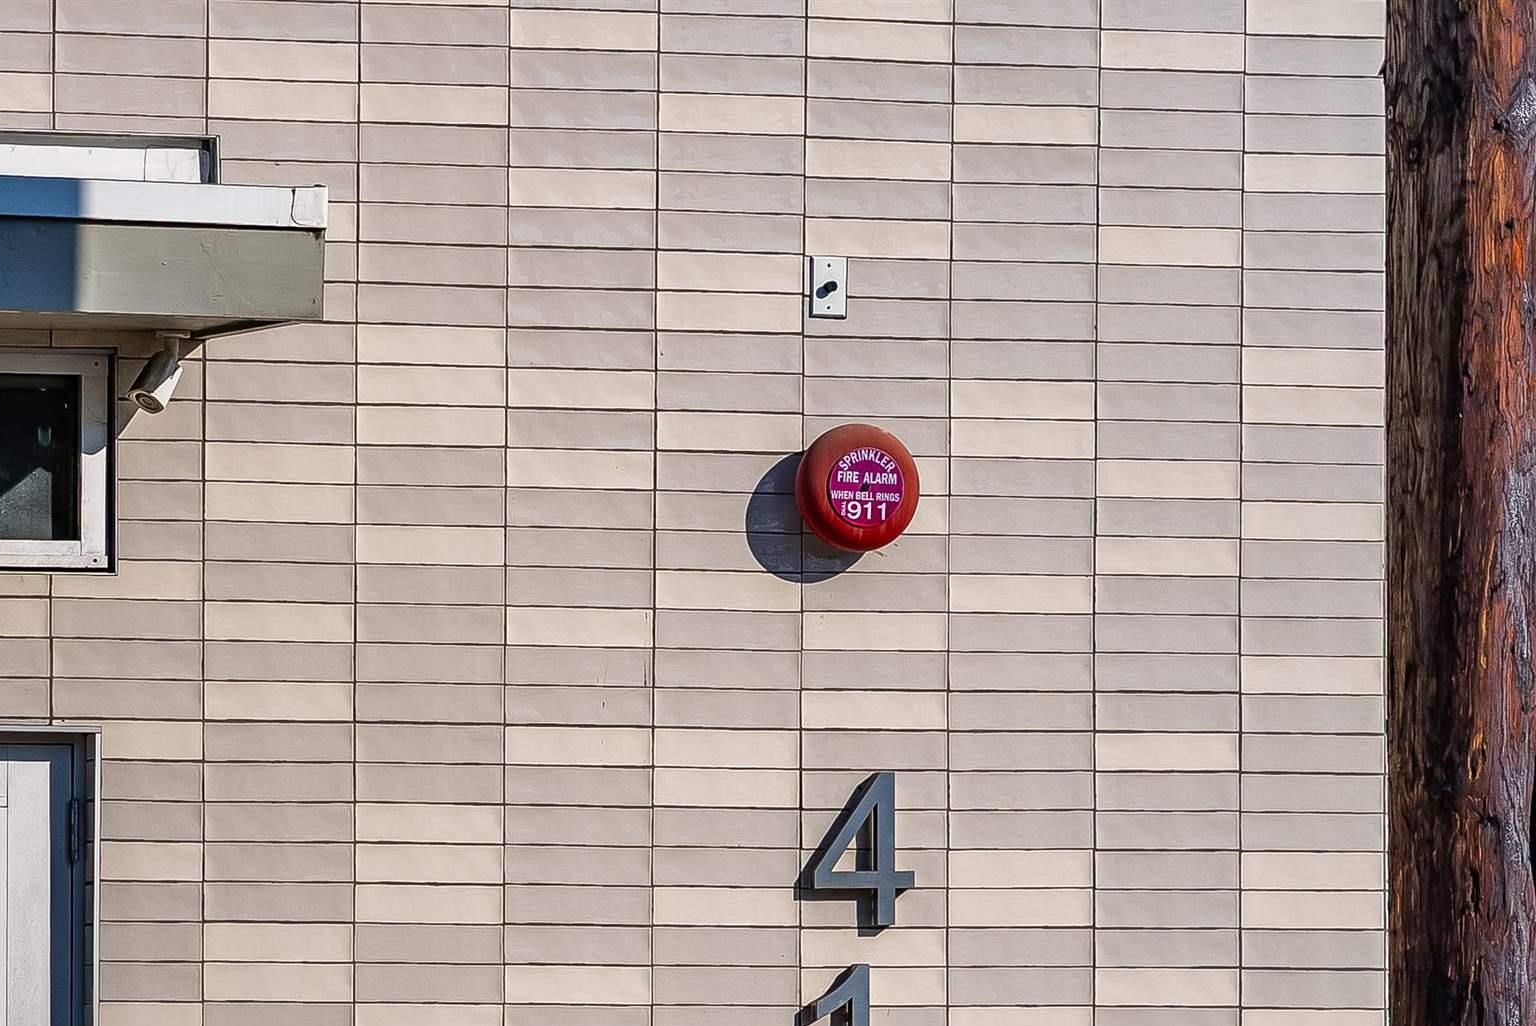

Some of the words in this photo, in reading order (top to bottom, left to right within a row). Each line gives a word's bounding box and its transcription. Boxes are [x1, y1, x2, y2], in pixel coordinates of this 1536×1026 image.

[838, 449, 896, 473] SPRINKLER
[837, 470, 860, 483] FIRE
[863, 472, 897, 485] ALARM
[830, 489, 854, 500] WHEN
[855, 491, 875, 501] BELL
[875, 492, 900, 502] RINGS
[847, 501, 887, 521] 911
